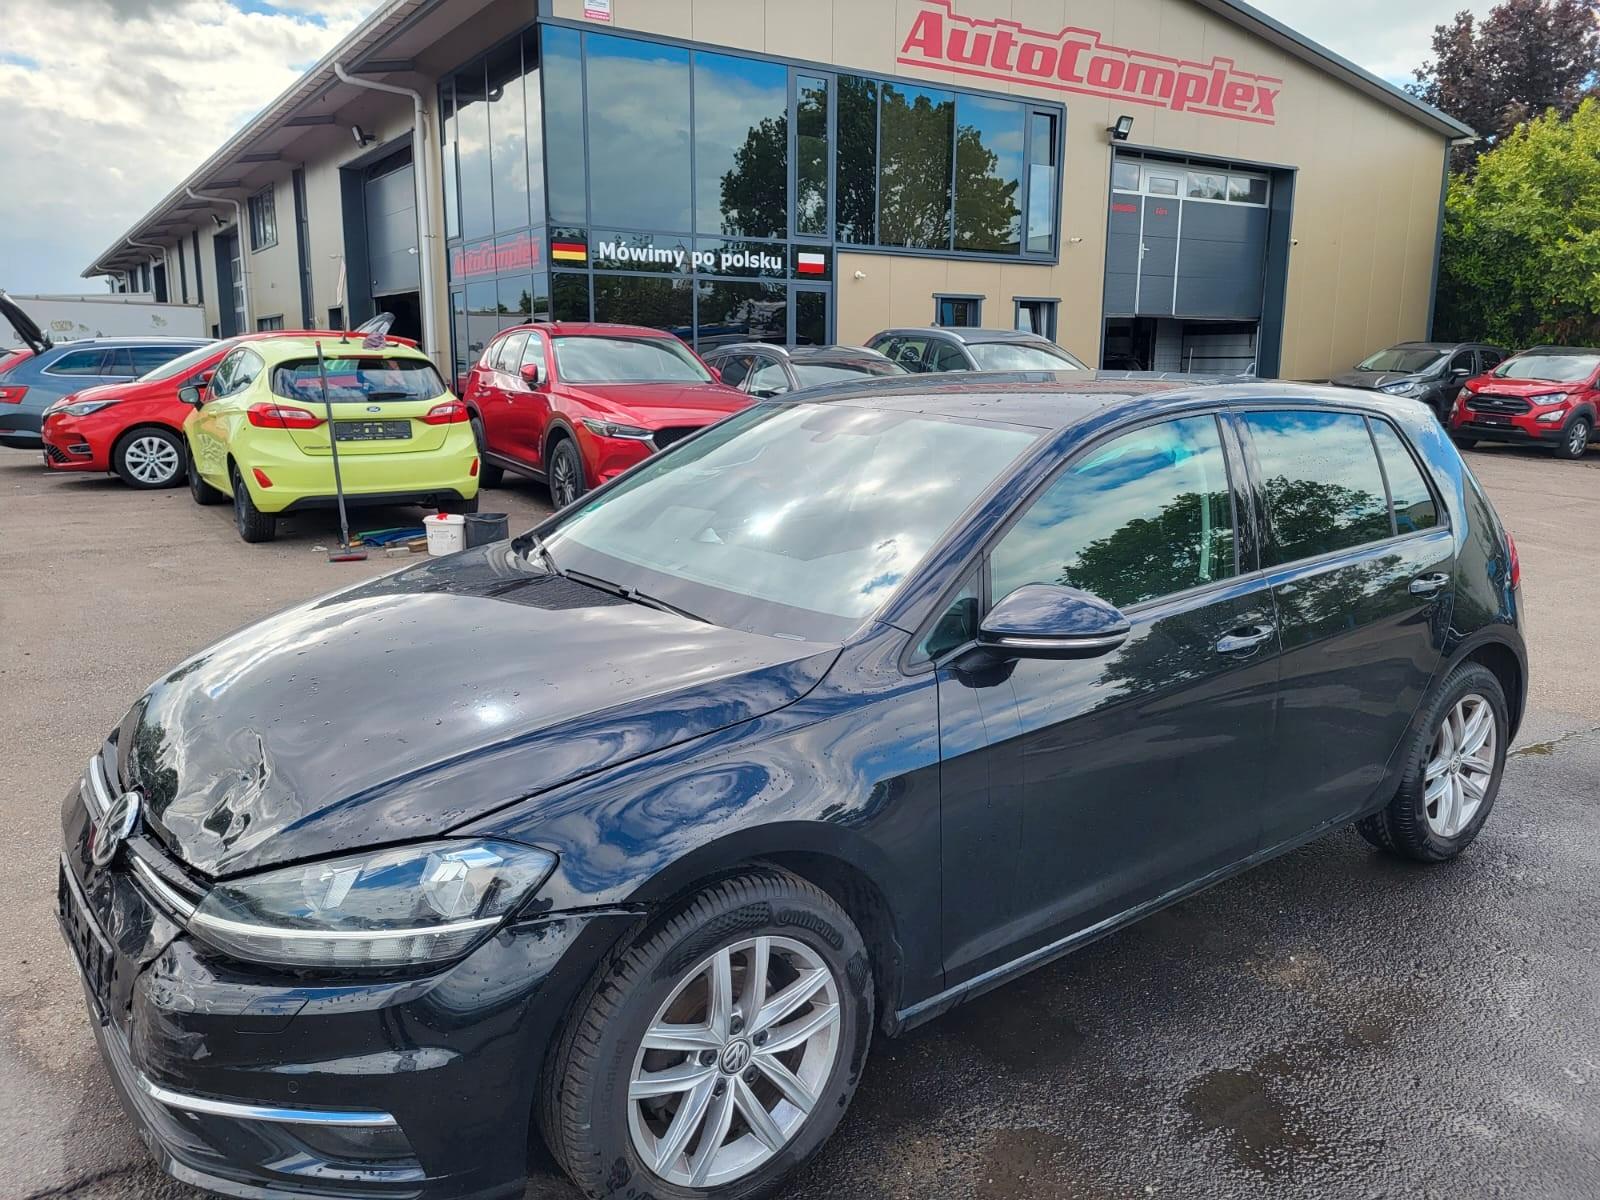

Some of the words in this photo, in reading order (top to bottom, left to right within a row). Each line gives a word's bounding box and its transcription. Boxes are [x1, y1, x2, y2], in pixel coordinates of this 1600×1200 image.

[901, 10, 1280, 117] AutoComplex
[599, 242, 686, 267] Mówimy
[692, 251, 715, 268] po
[721, 250, 783, 269] polsku
